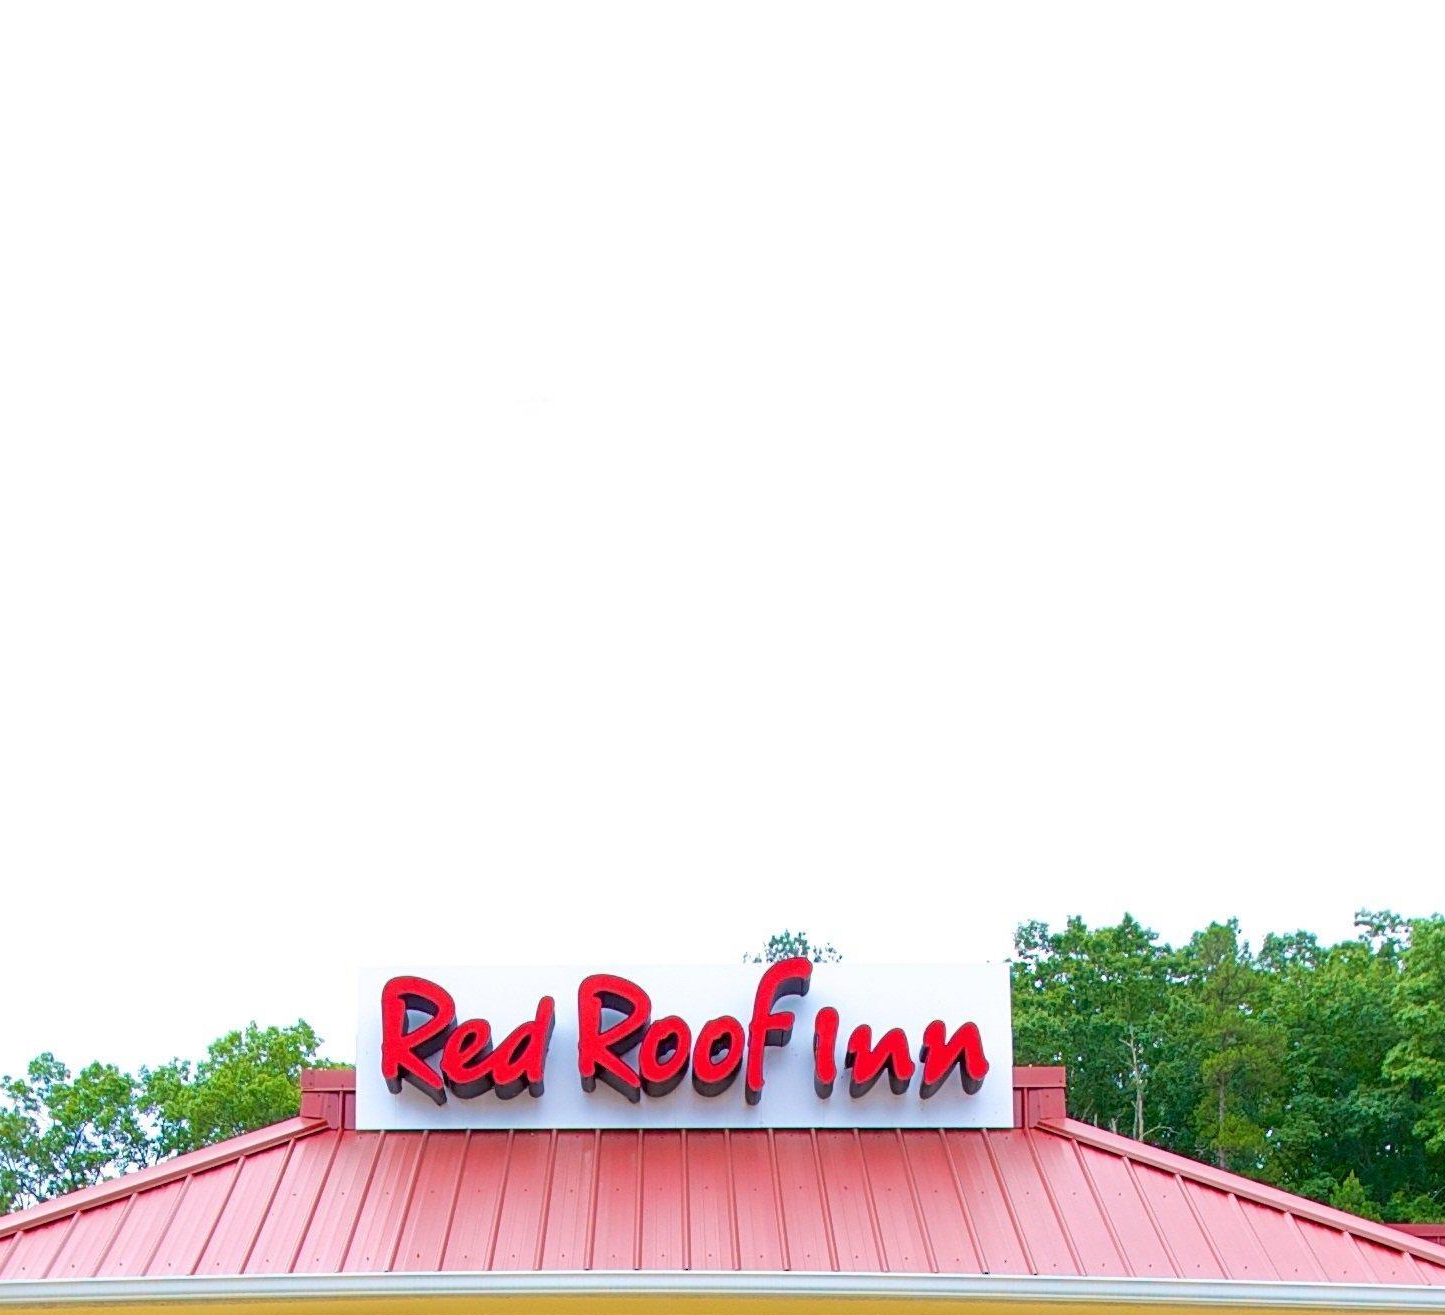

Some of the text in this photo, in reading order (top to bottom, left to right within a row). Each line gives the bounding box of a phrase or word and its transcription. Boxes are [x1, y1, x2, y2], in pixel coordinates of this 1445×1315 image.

[381, 957, 990, 1100] Red Roof Inn
